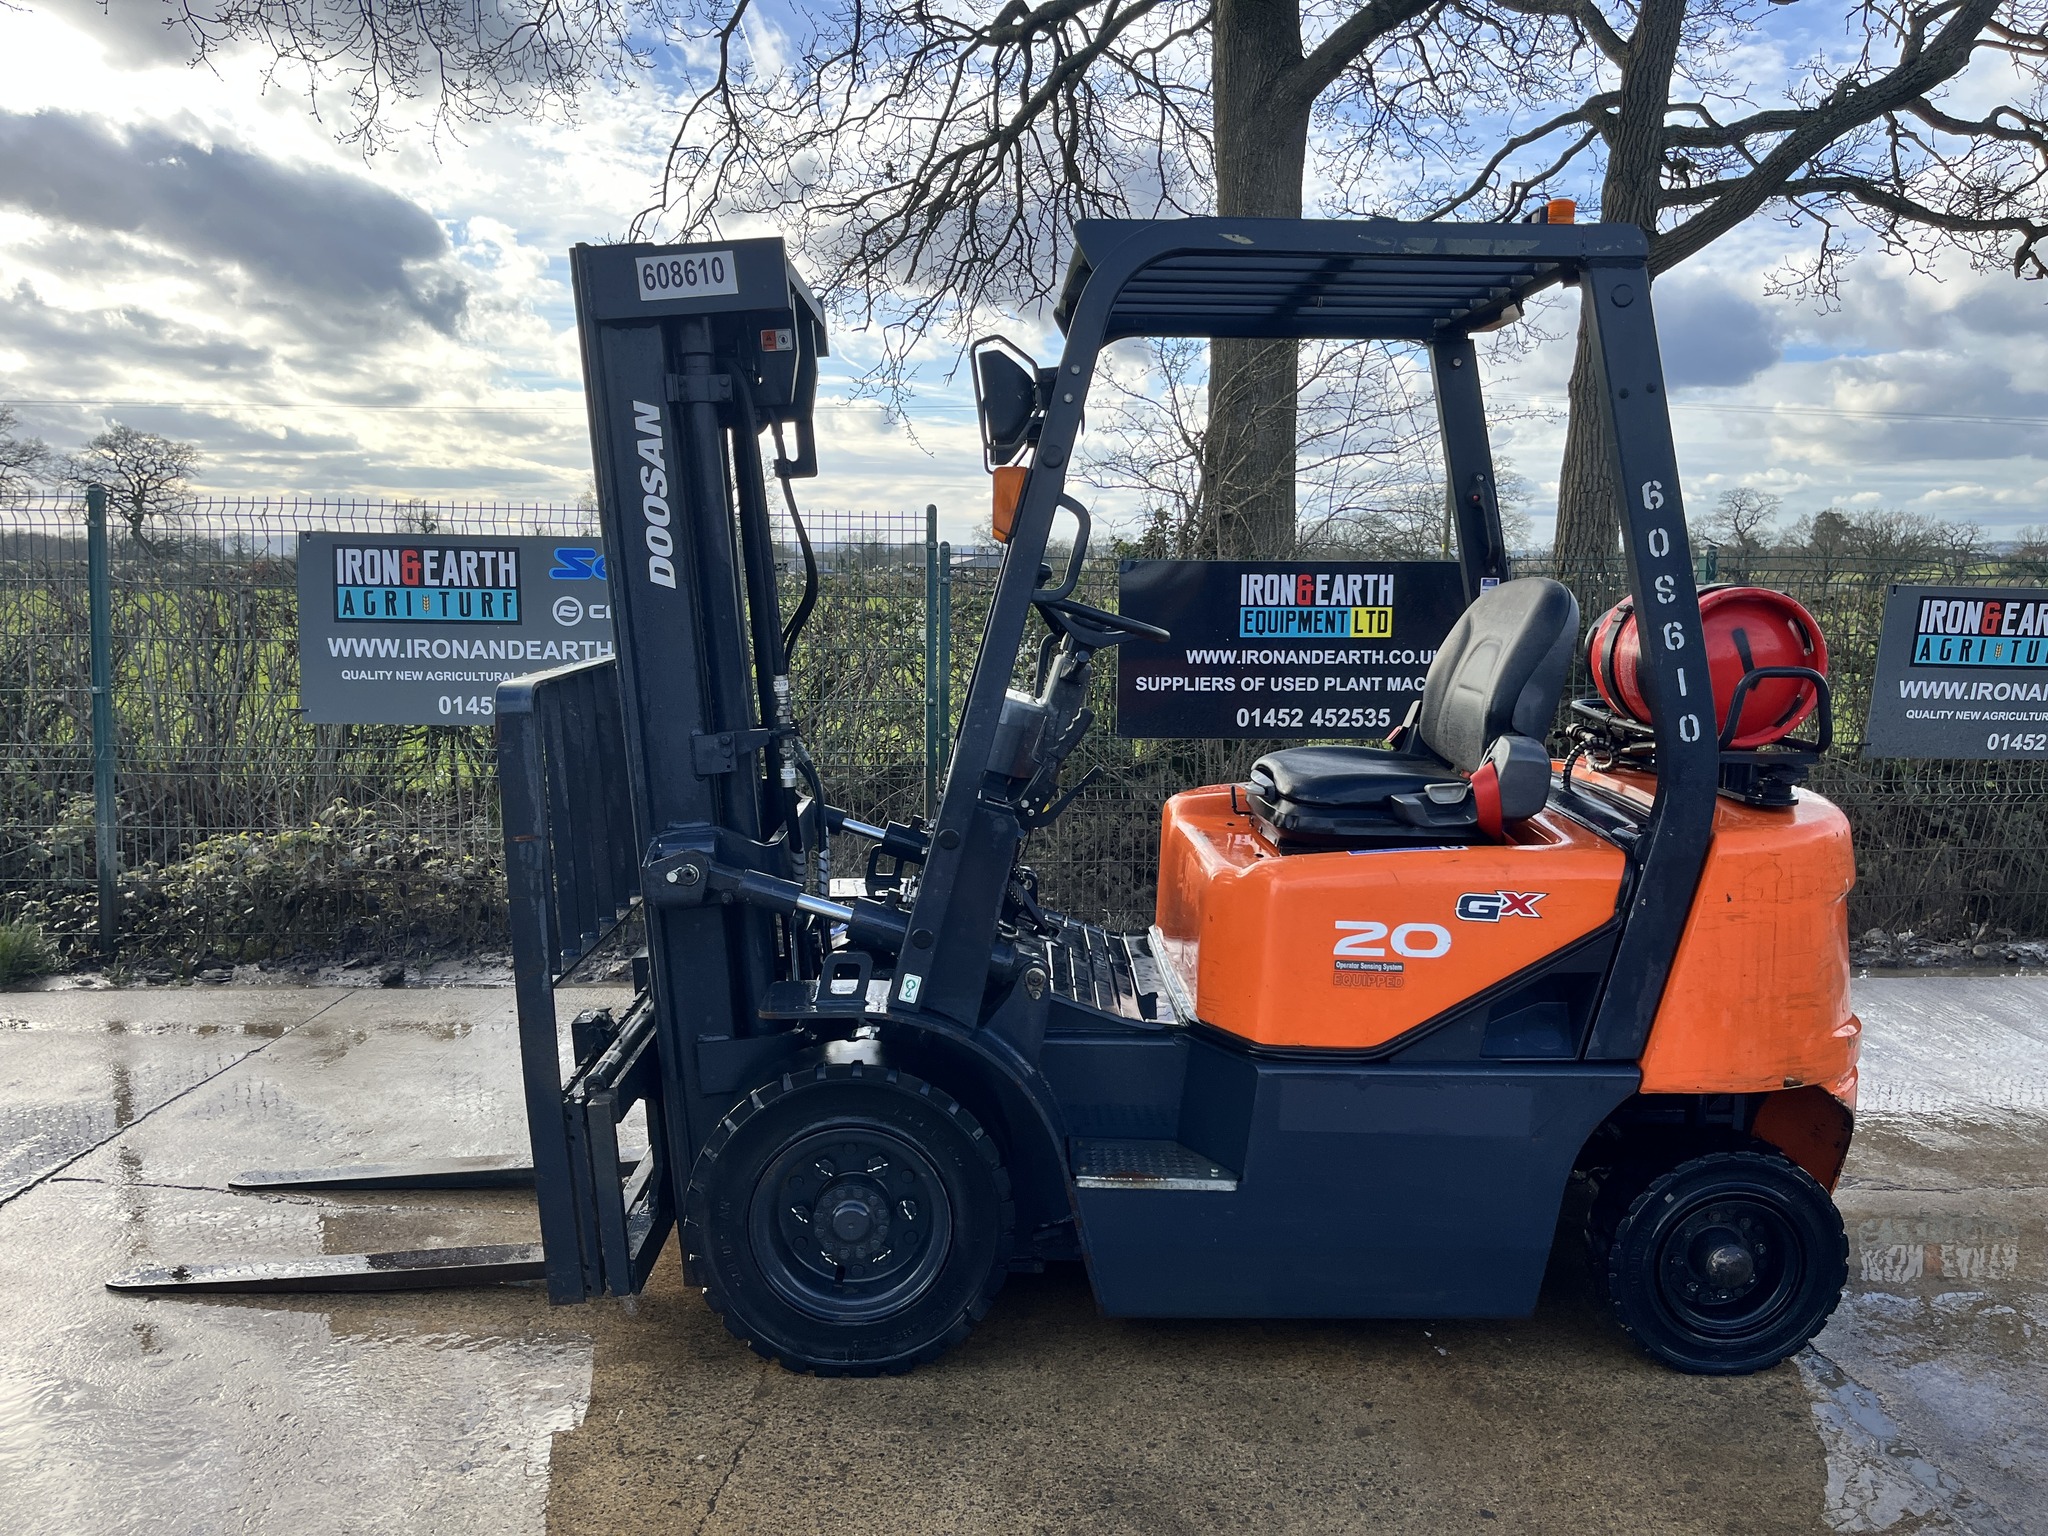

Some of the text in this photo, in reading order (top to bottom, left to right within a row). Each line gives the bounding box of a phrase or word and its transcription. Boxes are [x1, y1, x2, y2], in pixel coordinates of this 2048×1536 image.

[642, 256, 725, 291] 608610
[632, 399, 677, 590] DOOSAN
[336, 547, 517, 588] IRON&EARTH
[1240, 574, 1394, 606] IRON&EARTH
[342, 589, 513, 619] AGRI TURF
[1243, 610, 1390, 635] EQUIPMENT LTD
[1185, 649, 1437, 666] WWW.IRONANDEARTH.CO.U
[1919, 637, 2048, 664] AGRI TU
[341, 669, 392, 681] QUALITY
[396, 671, 424, 682] NEW
[1135, 676, 1426, 692] SUPPLIERS OF USED PLANT MAC
[1899, 680, 2048, 701] WWW.IRONA
[438, 696, 496, 716] 0145
[1905, 709, 1955, 720] QUALITY
[1955, 711, 1981, 721] NEW
[1236, 707, 1391, 729] 01452 452535
[1986, 733, 2047, 751] 01452
[1455, 890, 1550, 924] GX
[1333, 920, 1452, 958] 20
[1335, 961, 1403, 972] Operator Sensing System
[1333, 973, 1404, 988] EQUIPPED
